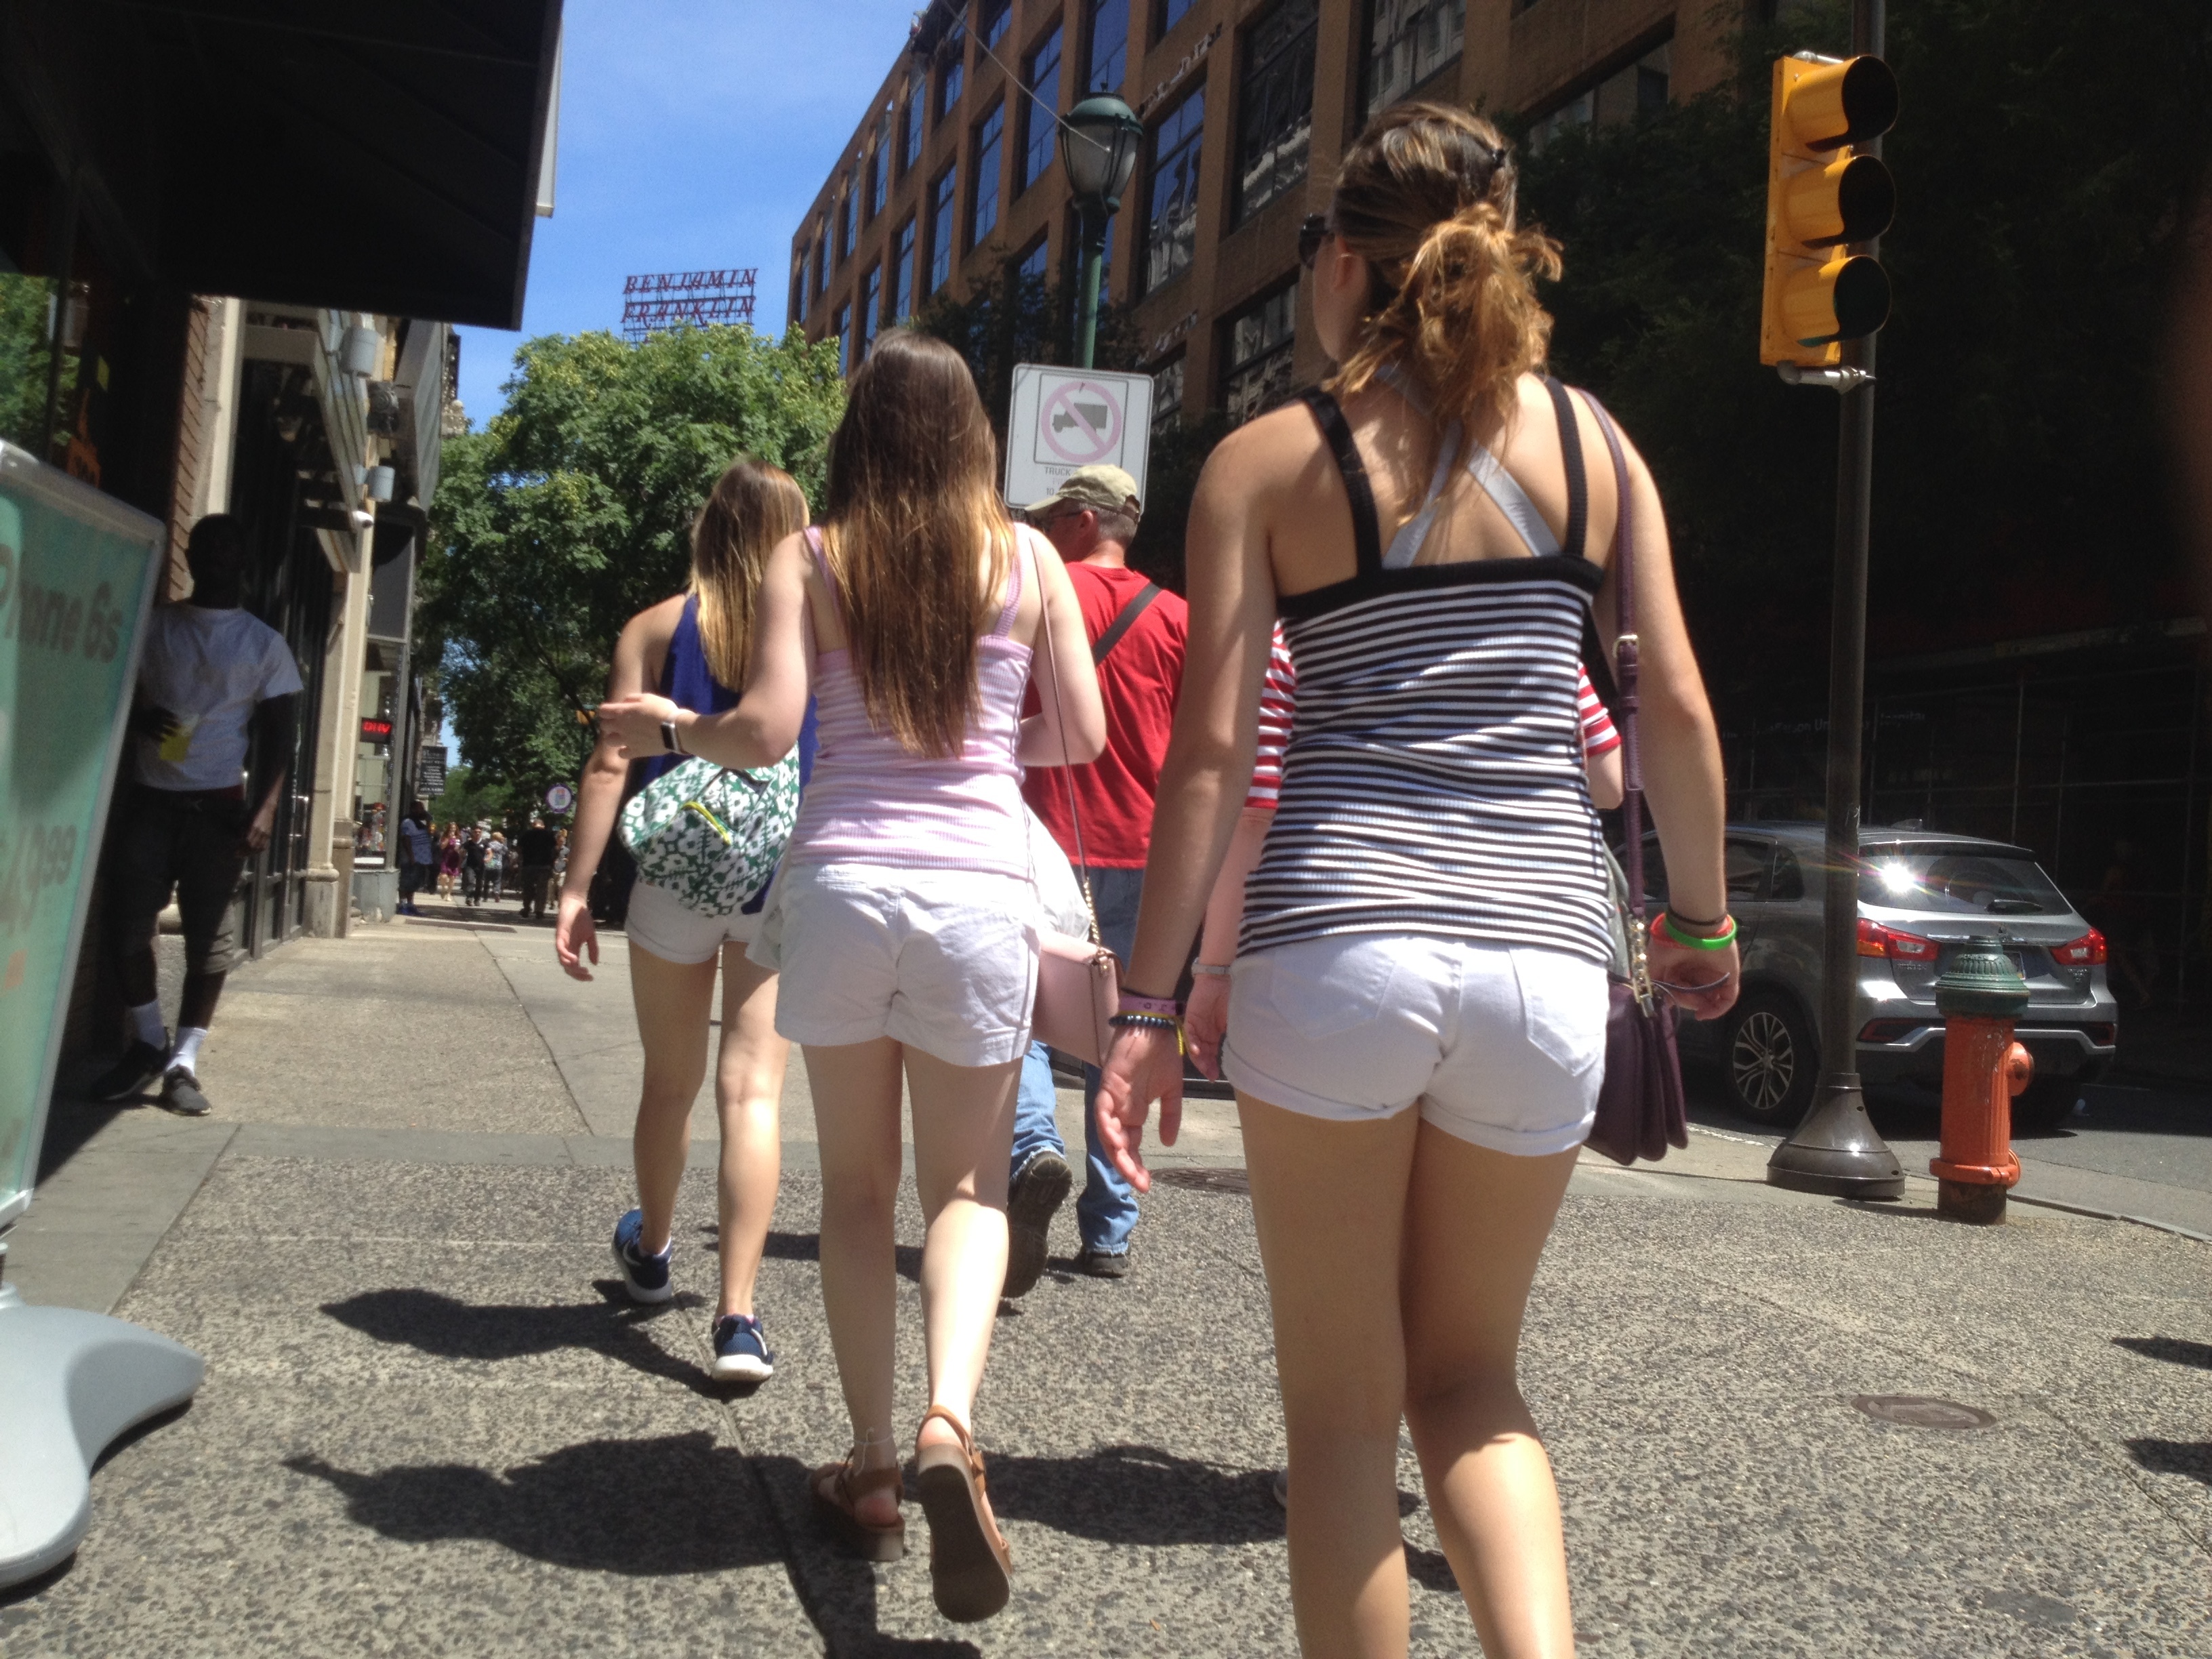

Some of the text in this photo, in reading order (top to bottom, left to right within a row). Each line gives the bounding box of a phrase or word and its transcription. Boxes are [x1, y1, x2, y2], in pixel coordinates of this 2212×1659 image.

[623, 268, 758, 294] BENJAMIN
[621, 295, 756, 329] FRANKLIN
[1044, 466, 1071, 476] TRUCK
[82, 579, 123, 663] 6s
